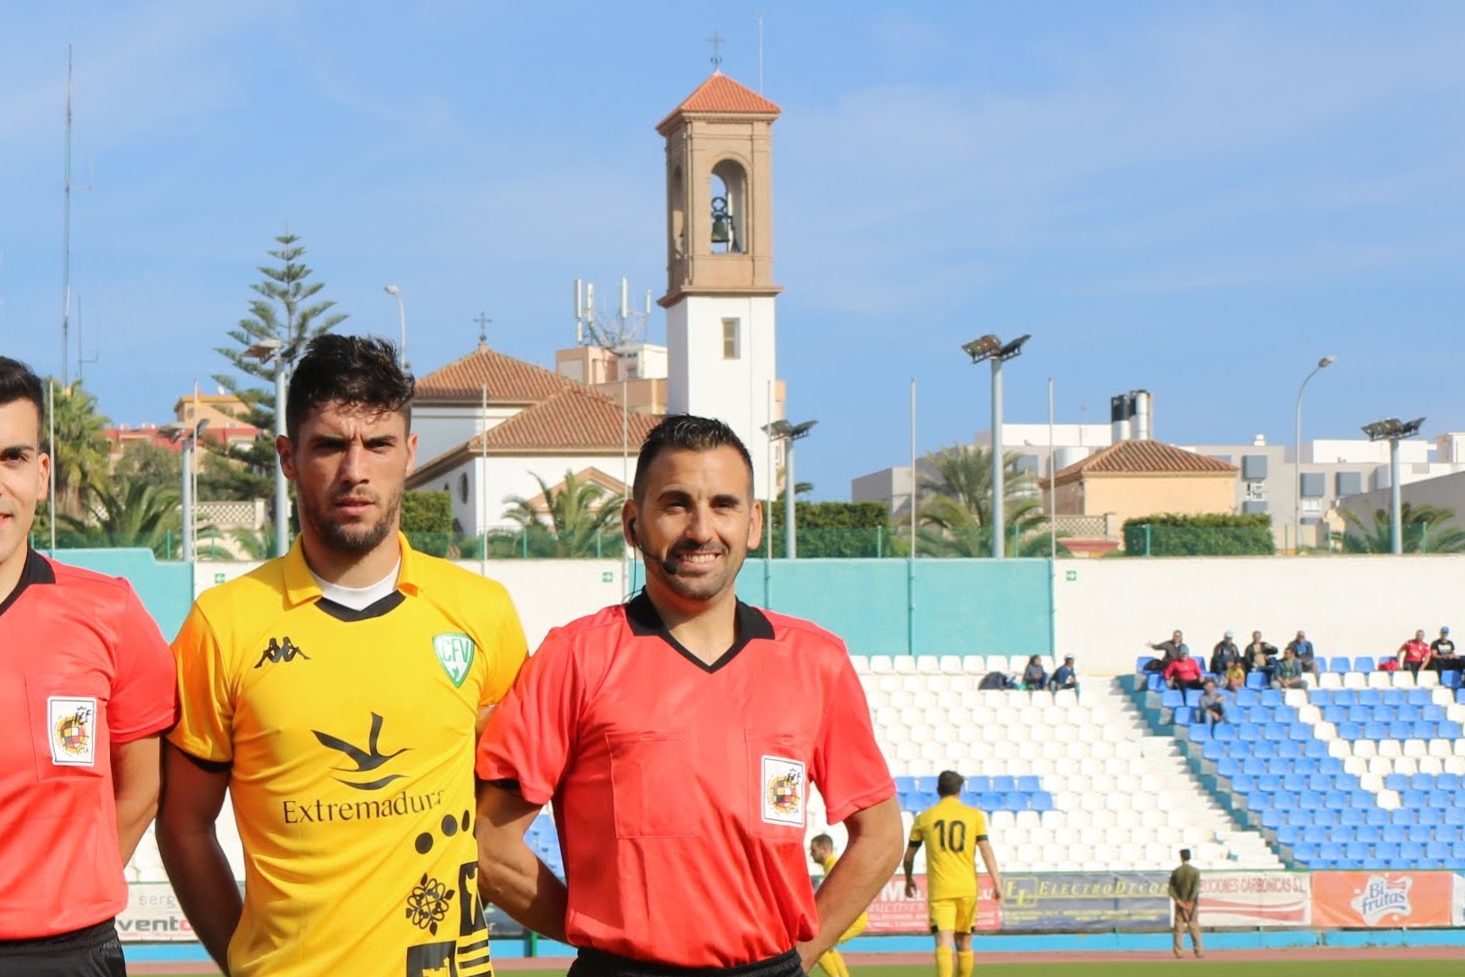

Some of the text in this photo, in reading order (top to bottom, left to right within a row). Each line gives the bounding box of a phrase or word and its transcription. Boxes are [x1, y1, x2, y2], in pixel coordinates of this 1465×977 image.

[442, 638, 469, 663] CFV
[934, 819, 966, 853] 10
[1370, 881, 1385, 899] Bi
[1362, 891, 1406, 915] frutas
